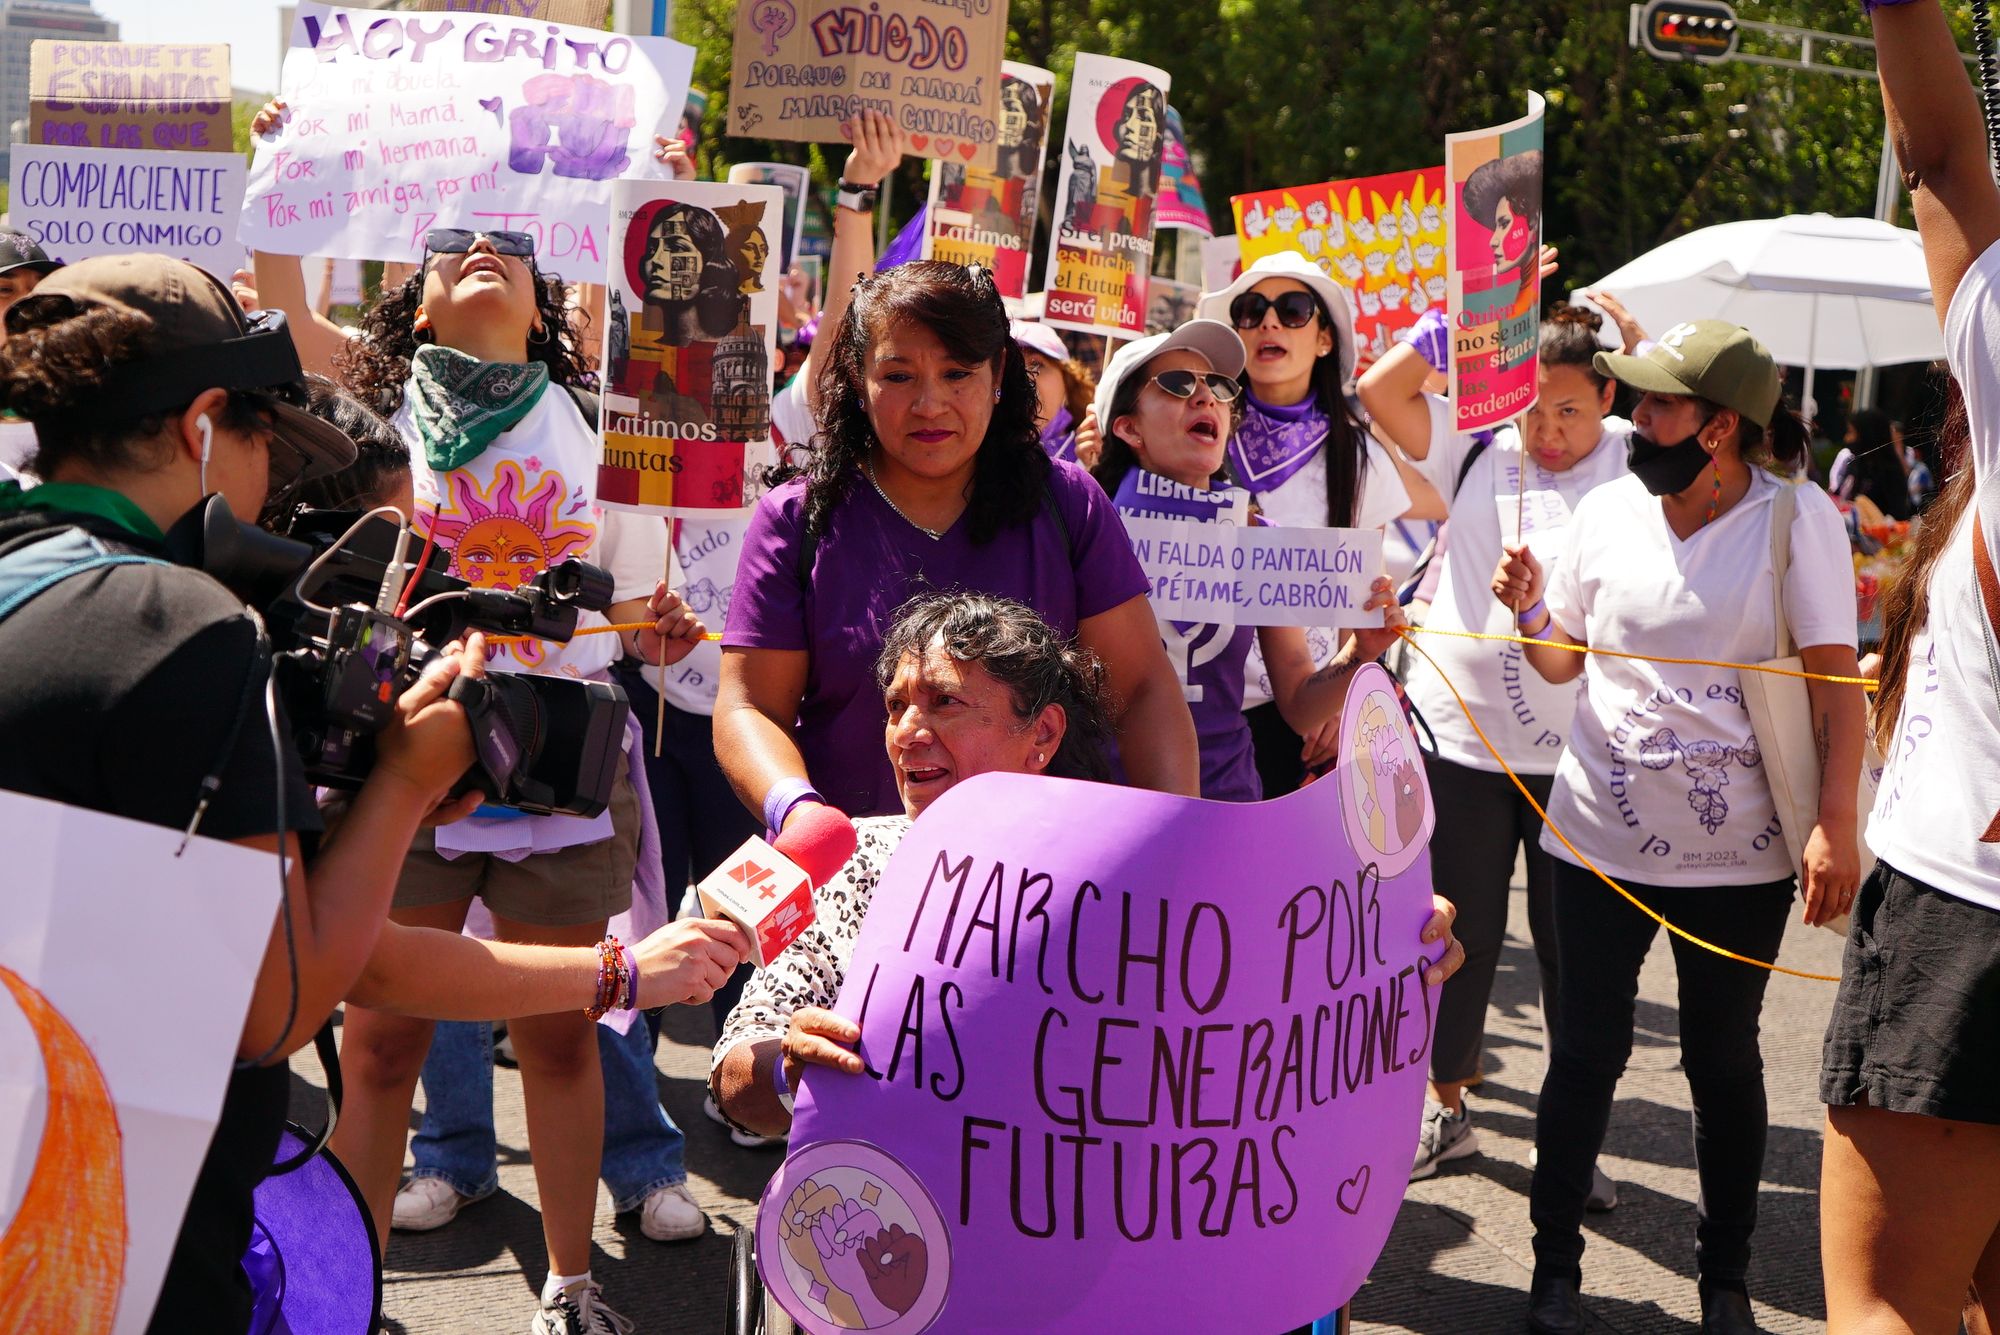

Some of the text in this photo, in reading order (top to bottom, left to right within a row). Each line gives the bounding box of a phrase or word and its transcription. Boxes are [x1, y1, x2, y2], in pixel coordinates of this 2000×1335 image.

[302, 14, 454, 63] HOY
[901, 76, 982, 105] MAMÁ
[347, 104, 369, 133] mi
[389, 96, 464, 127] Mamá.
[779, 94, 893, 122] MARCHA
[43, 120, 210, 149] POR LAS QUE
[344, 140, 367, 171] mi
[379, 136, 486, 165] hermana.
[21, 160, 227, 214] COMPLACIENTE
[310, 191, 334, 219] mi
[27, 220, 222, 246] SOLO CONMIGO
[932, 221, 1021, 251] Latimos
[1060, 219, 1080, 239] Si
[1056, 249, 1135, 275] es lucha
[1055, 270, 1134, 299] el futuro
[1049, 297, 1137, 325] será vida
[1456, 304, 1516, 332] Quien
[1457, 329, 1508, 352] no se
[1457, 335, 1535, 375] no siente
[1457, 379, 1488, 397] las
[1458, 382, 1530, 419] cadenas
[603, 408, 717, 442] Latimos
[603, 441, 683, 473] juntas
[1158, 541, 1225, 569] FALDA
[1231, 547, 1244, 570] O
[1251, 542, 1362, 574] PANTALÓN
[1259, 580, 1354, 609] CABRÓN.
[1682, 850, 1738, 862] 8M 2023
[904, 850, 1386, 1015] MARCHO POR
[857, 956, 1433, 1135] LAS GENERACIONES
[960, 1116, 1299, 1242] FUTURAS
